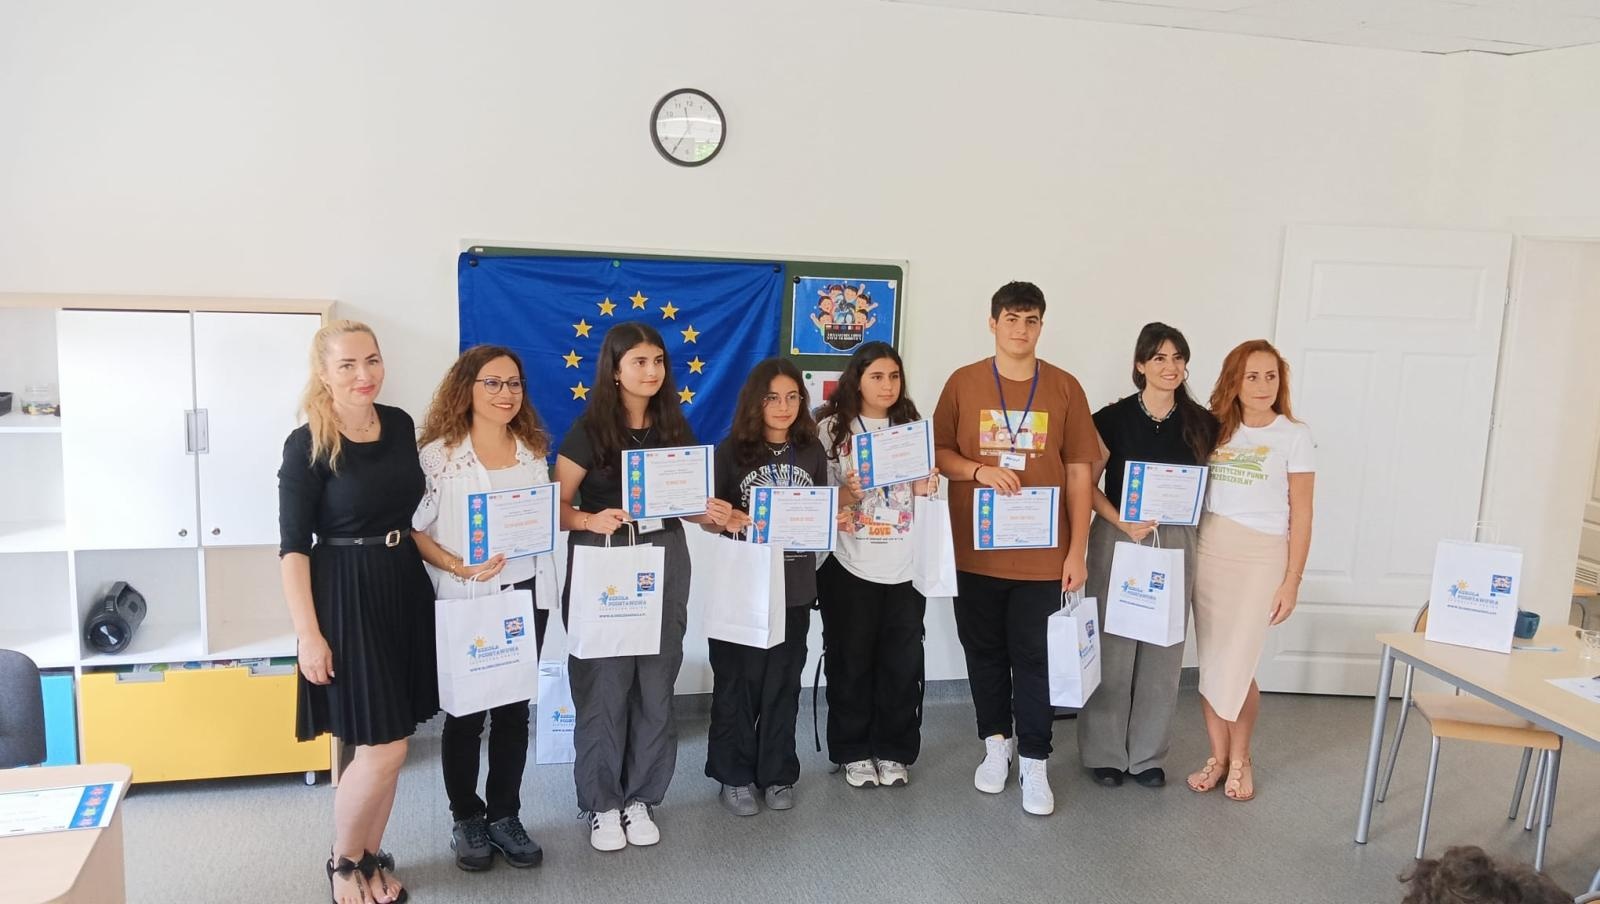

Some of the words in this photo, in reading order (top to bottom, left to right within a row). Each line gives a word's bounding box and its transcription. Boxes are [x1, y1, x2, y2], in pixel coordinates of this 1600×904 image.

[740, 470, 758, 492] FIND
[759, 464, 777, 476] THE
[868, 526, 892, 536] LOVE
